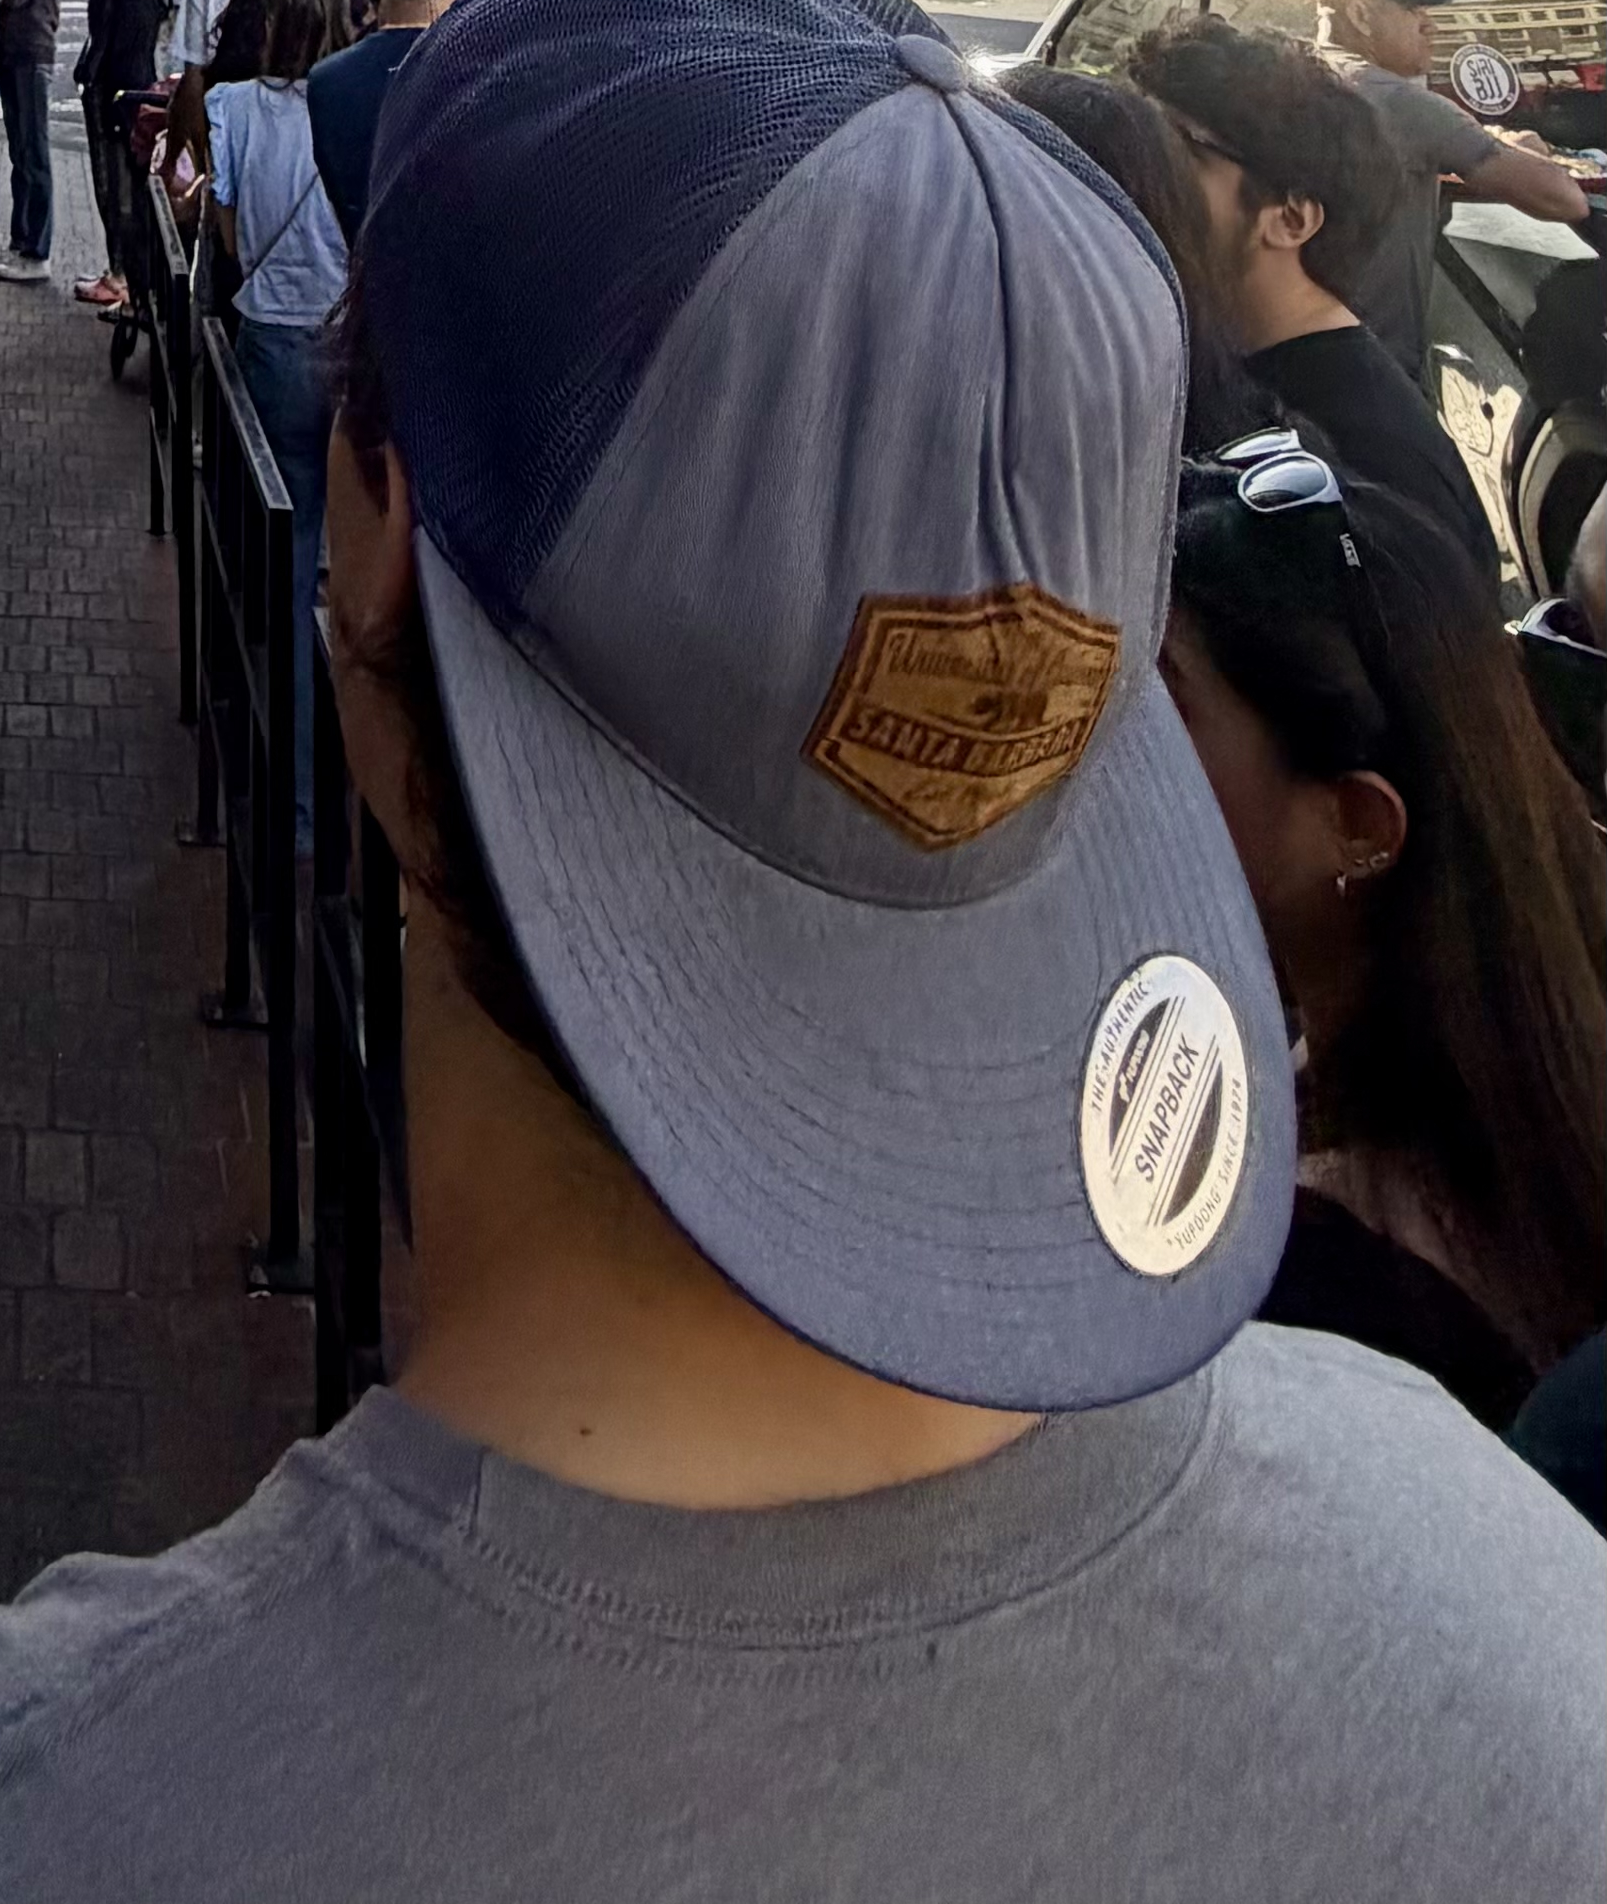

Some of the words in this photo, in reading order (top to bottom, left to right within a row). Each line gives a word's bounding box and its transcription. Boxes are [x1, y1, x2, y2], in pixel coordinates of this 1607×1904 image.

[1466, 58, 1496, 78] SIRI
[1472, 76, 1503, 101] BJJ
[847, 709, 962, 770] SANTA
[1134, 1031, 1200, 1184] SNAPBACK
